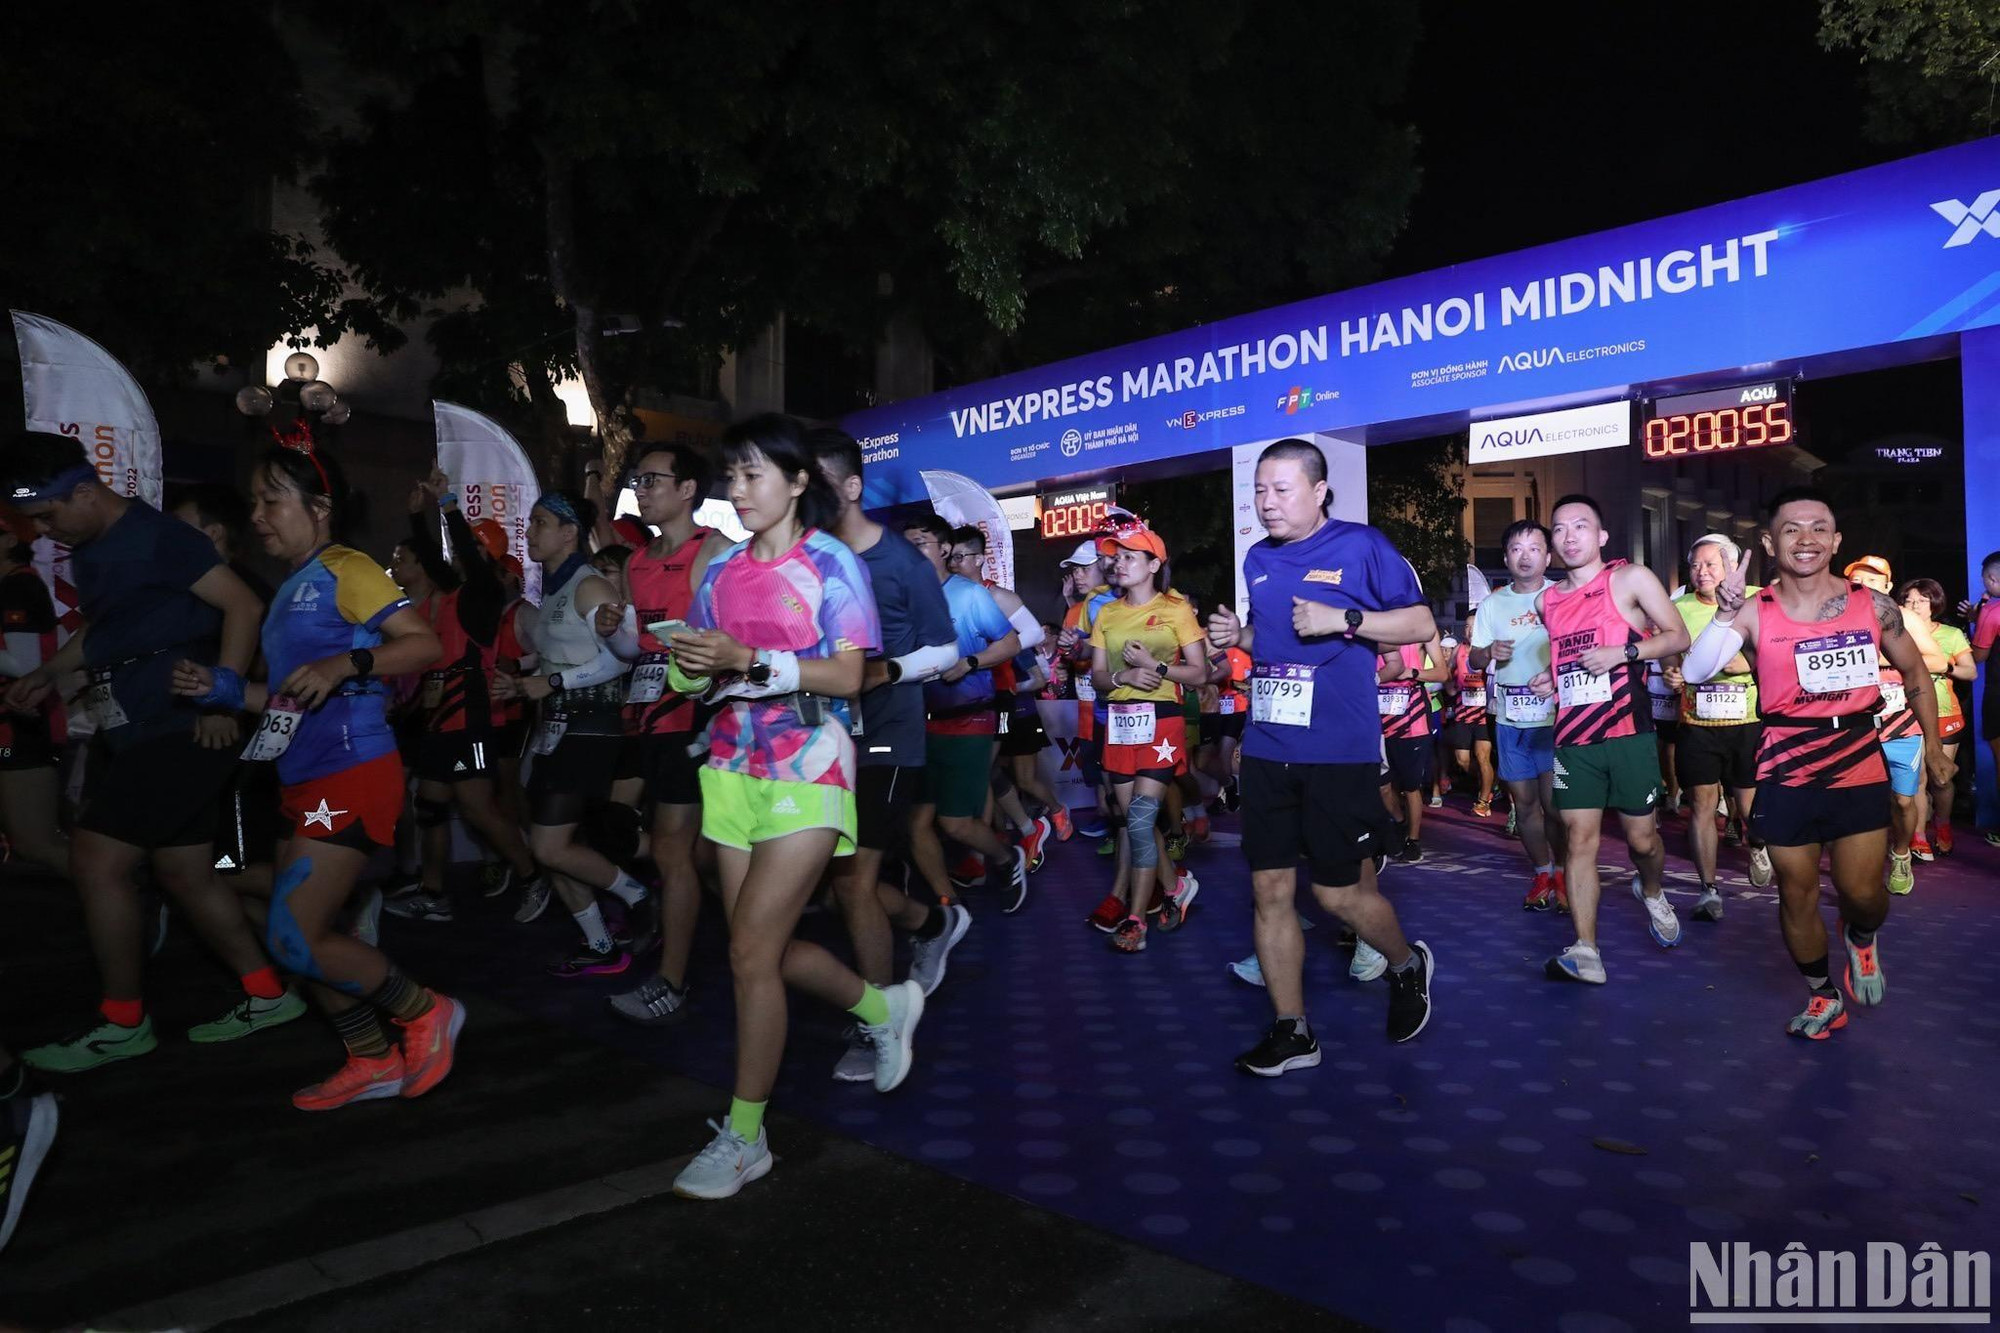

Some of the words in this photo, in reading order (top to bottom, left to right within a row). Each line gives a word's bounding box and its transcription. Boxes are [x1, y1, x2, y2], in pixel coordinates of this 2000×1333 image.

[951, 377, 1113, 438] VNEXPRESS
[1123, 325, 1329, 403] MARATHON
[1341, 291, 1486, 357] HANOI
[1501, 229, 1779, 328] MIDNIGHT
[1497, 346, 1565, 374] AQUA
[1566, 340, 1646, 363] ELECTRONICS
[1411, 374, 1450, 388] ASSOCIATE
[1451, 368, 1487, 381] SPONSOR
[1277, 391, 1312, 411] FPT
[1315, 390, 1340, 402] Online
[1166, 404, 1246, 430] VNEXPRESS
[1481, 428, 1544, 450] AQUA
[1546, 423, 1619, 443] ELECTRONICS
[1875, 448, 1912, 458] TRANG
[127, 468, 138, 496] 2022
[516, 517, 524, 541] 2022
[1808, 649, 1867, 671] 89511
[1257, 680, 1303, 698] 80799
[1706, 694, 1738, 703] 81122
[1512, 696, 1546, 706] 81249
[1114, 715, 1150, 727] 121077
